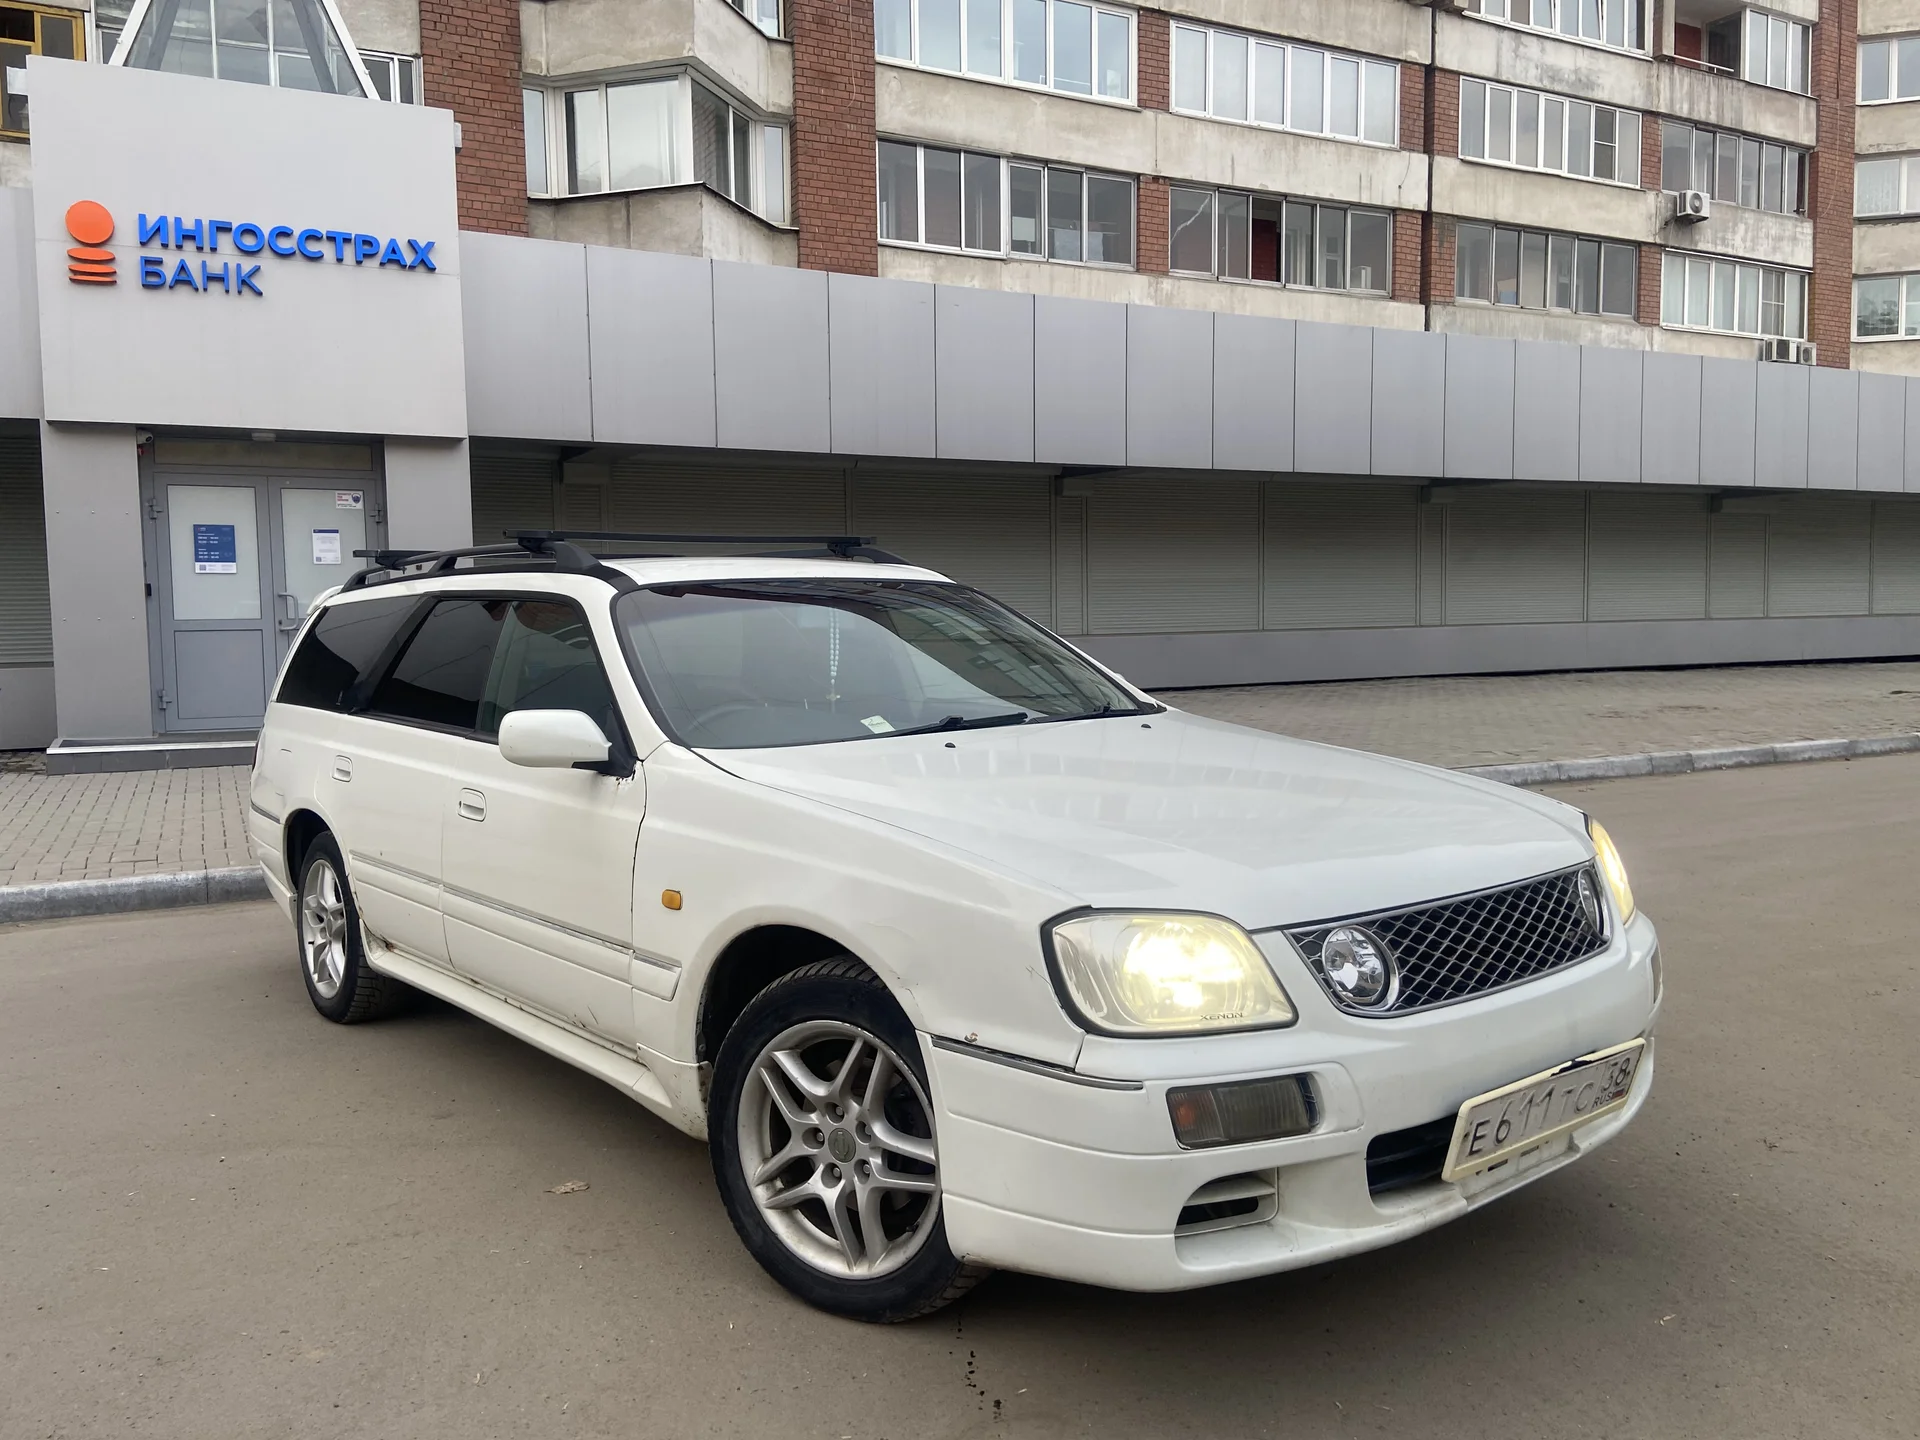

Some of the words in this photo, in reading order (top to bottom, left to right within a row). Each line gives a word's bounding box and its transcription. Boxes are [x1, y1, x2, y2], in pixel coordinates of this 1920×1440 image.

[138, 213, 436, 271] ИНГОССТРАХ
[139, 256, 263, 296] БАНК
[1602, 1057, 1630, 1091] 38
[1592, 1091, 1611, 1108] RUS
